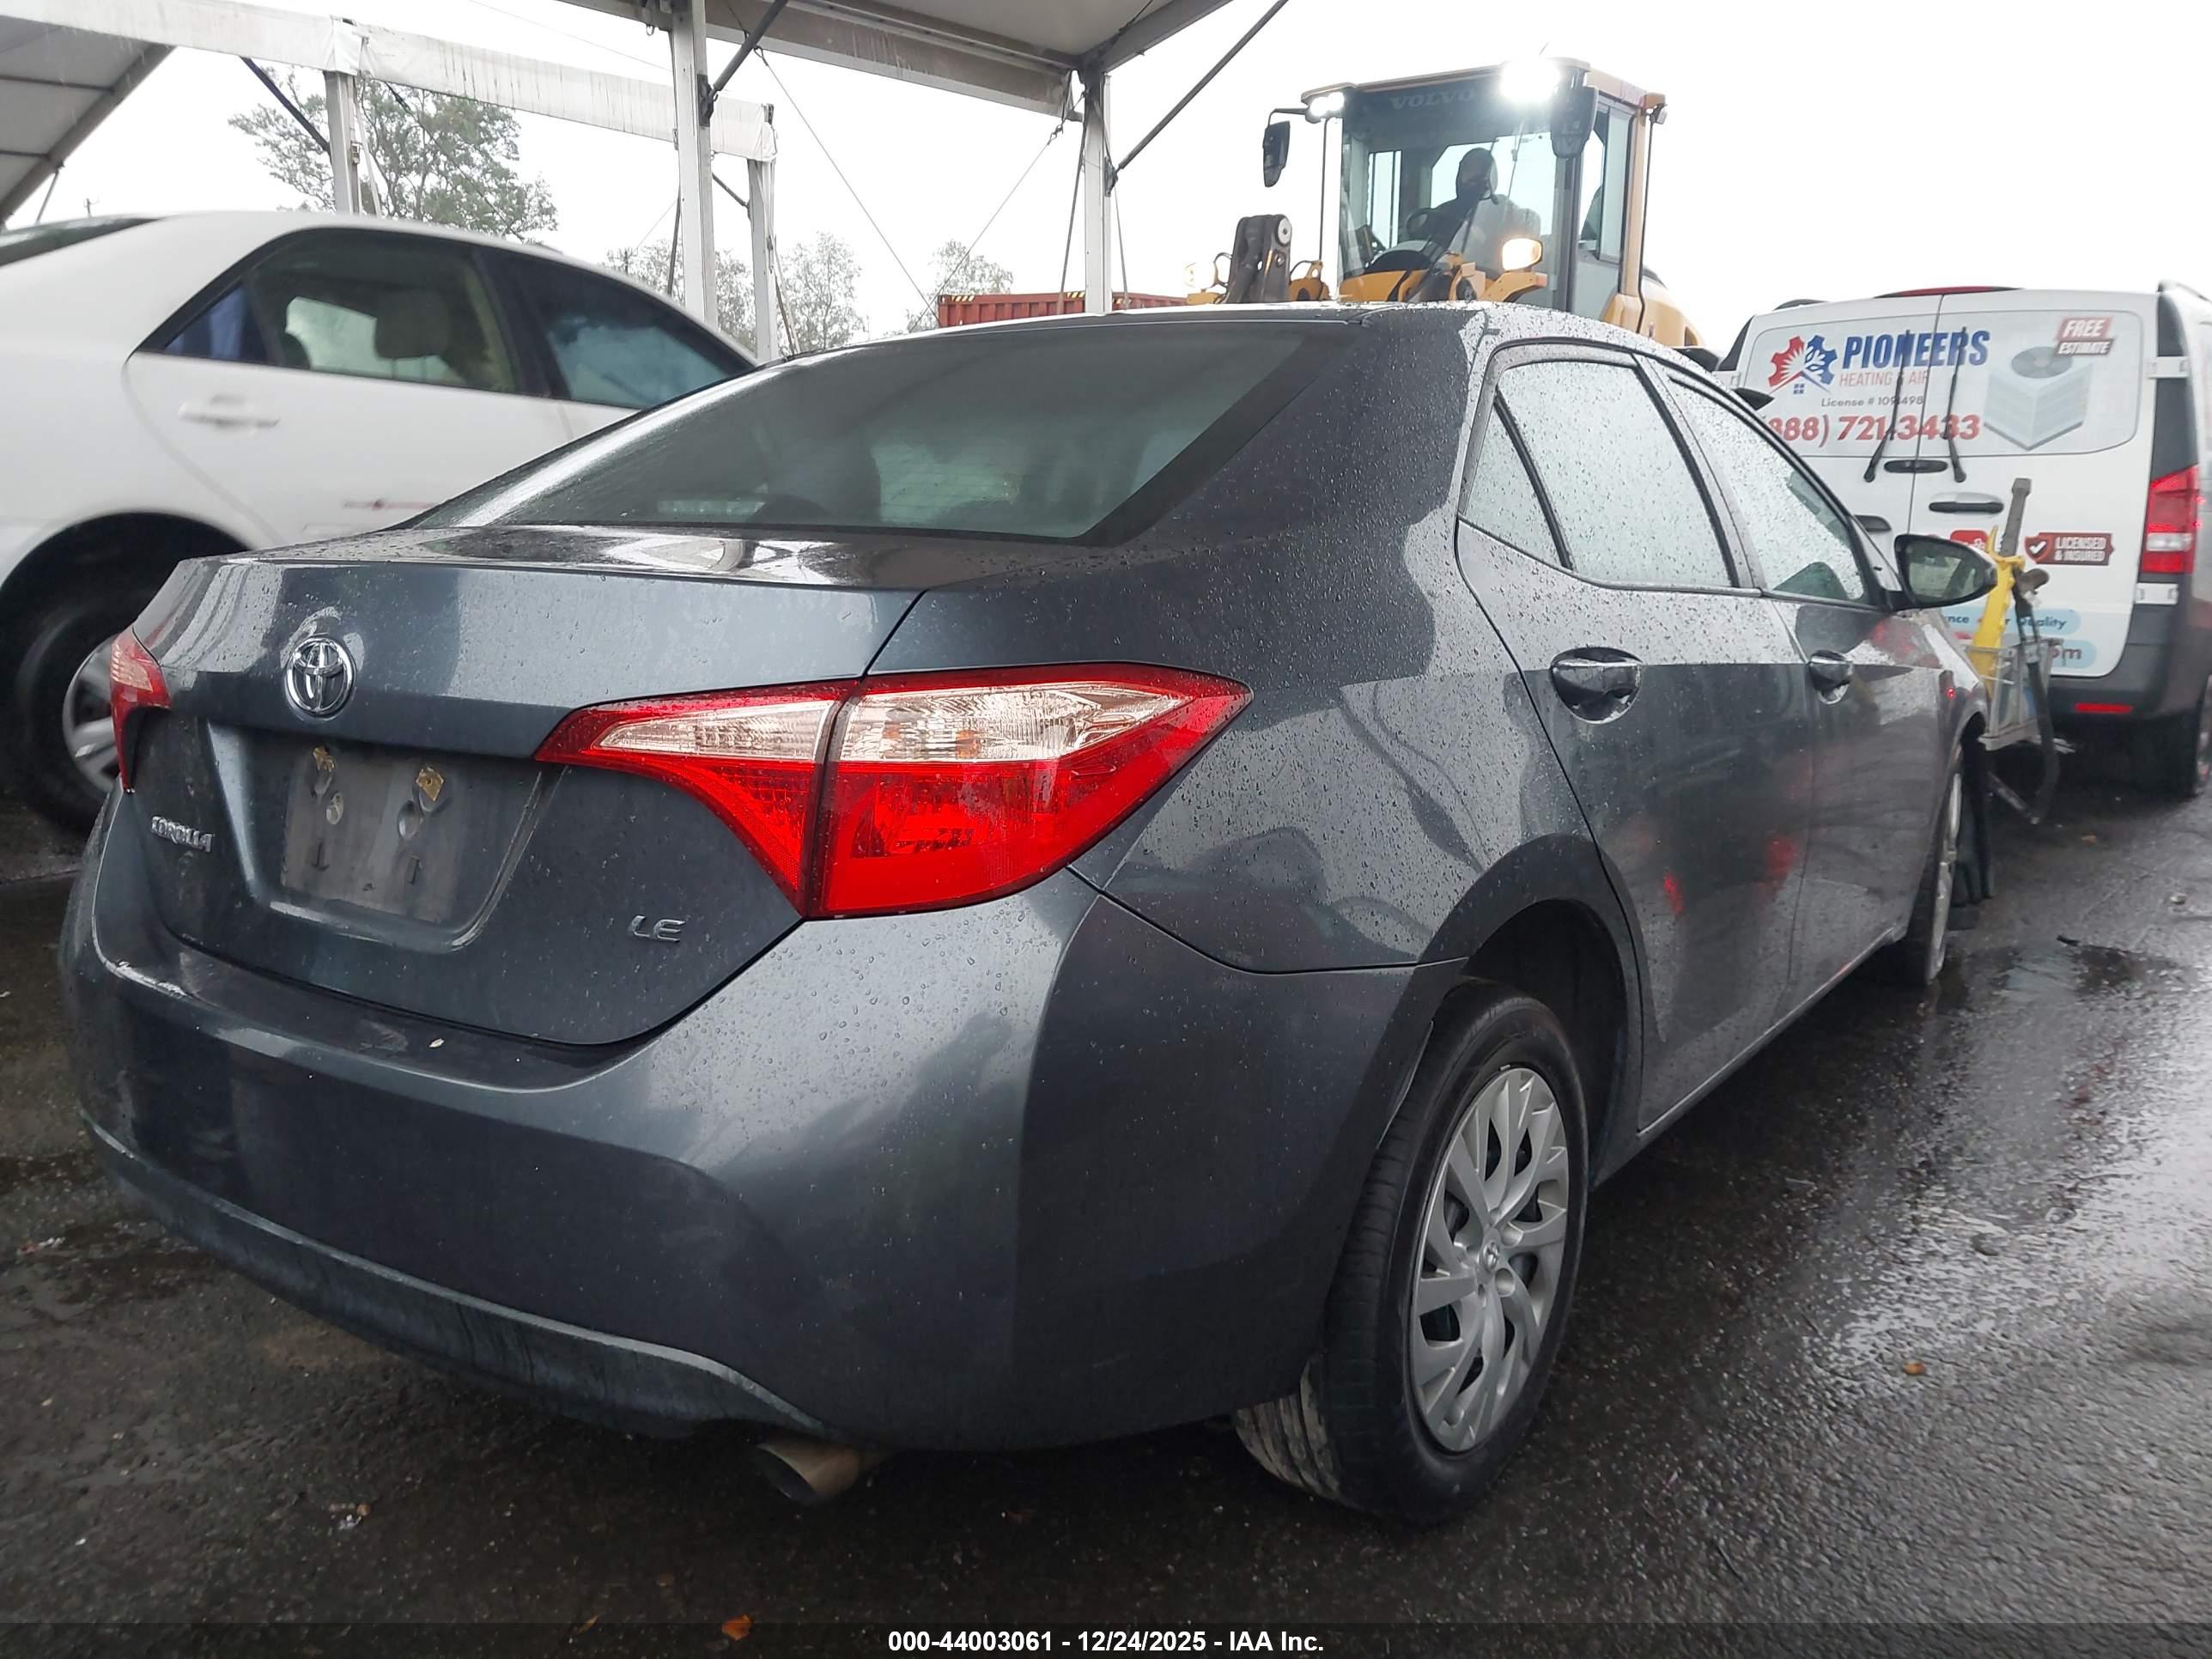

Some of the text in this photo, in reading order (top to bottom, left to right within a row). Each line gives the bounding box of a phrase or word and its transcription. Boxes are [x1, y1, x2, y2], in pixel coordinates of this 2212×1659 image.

[1389, 88, 1474, 110] VOLVO
[2062, 319, 2106, 337] FREE
[1842, 330, 1991, 369] PIONEERS
[1839, 371, 1893, 386] HEATING
[1908, 370, 1929, 386] AIR
[1821, 397, 1864, 407] License
[1878, 395, 1924, 406] 109498
[2054, 536, 2107, 550] LICENSED
[2063, 550, 2106, 562] INSURED
[151, 816, 213, 853] COROLLA
[631, 915, 686, 942] LE
